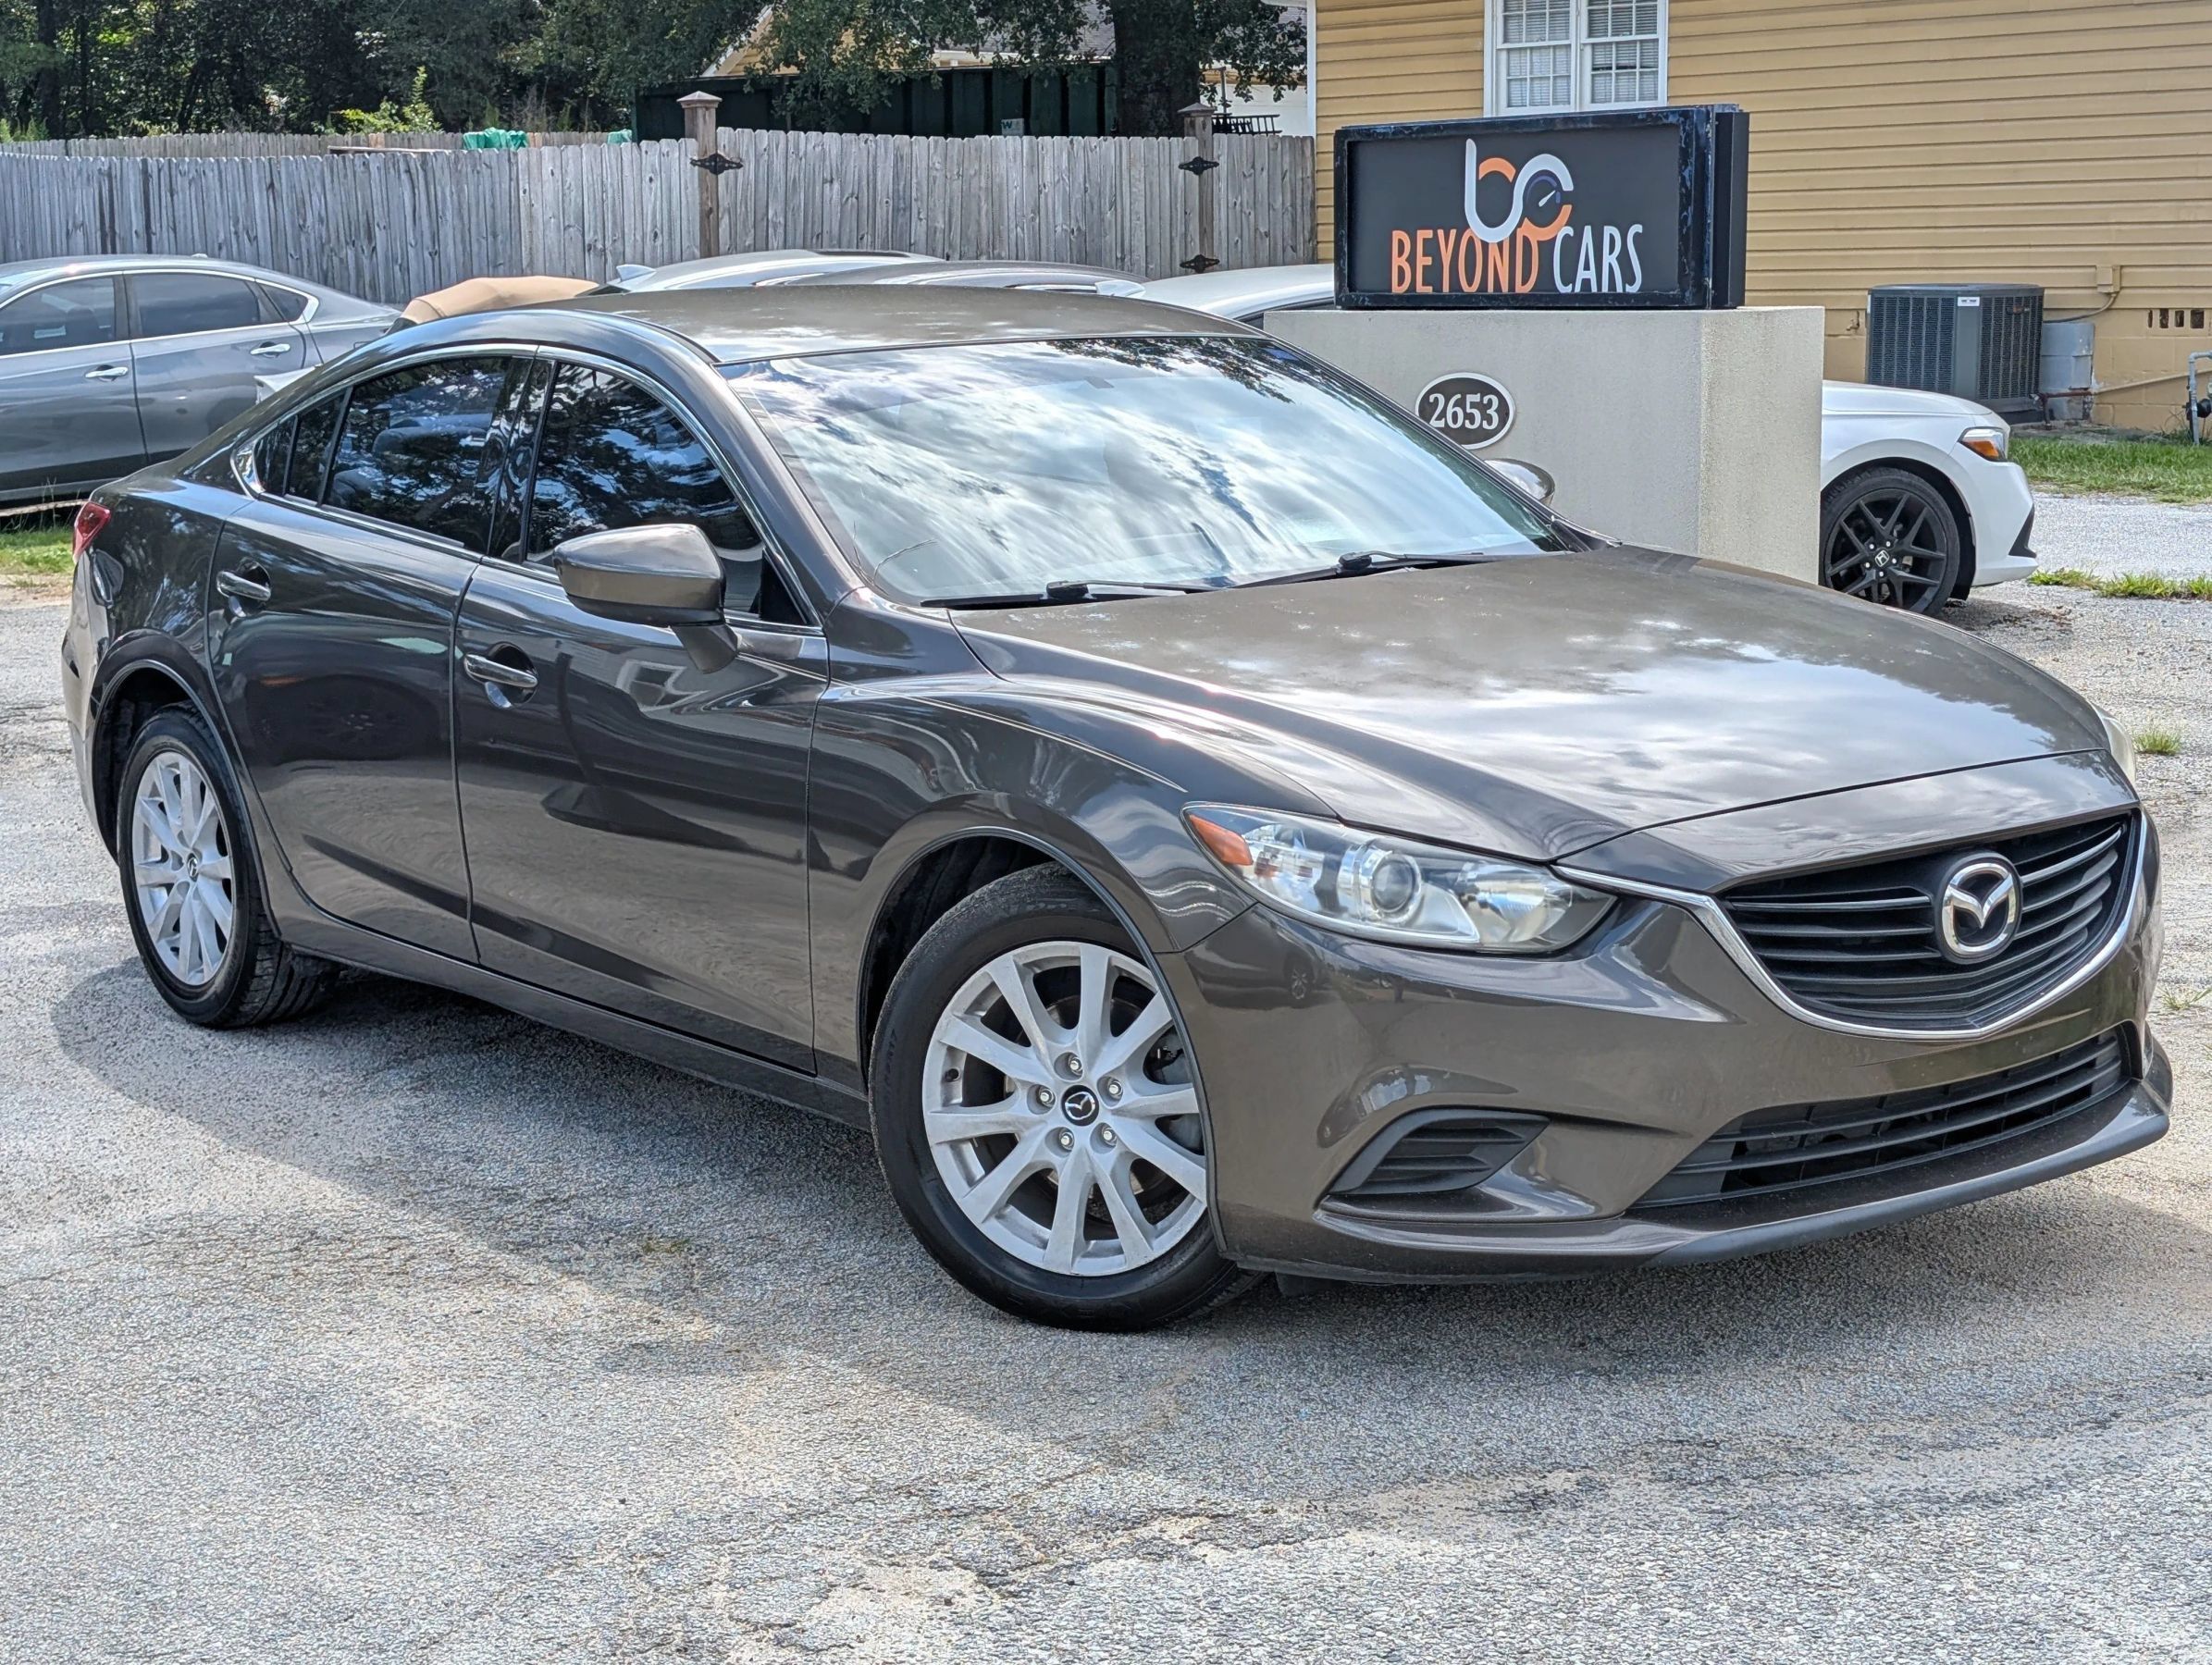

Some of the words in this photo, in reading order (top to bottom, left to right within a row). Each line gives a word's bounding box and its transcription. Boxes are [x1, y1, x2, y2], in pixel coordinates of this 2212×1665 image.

[1391, 228, 1539, 293] BEYOND
[1553, 224, 1642, 292] CARS
[1428, 393, 1499, 429] 2653
